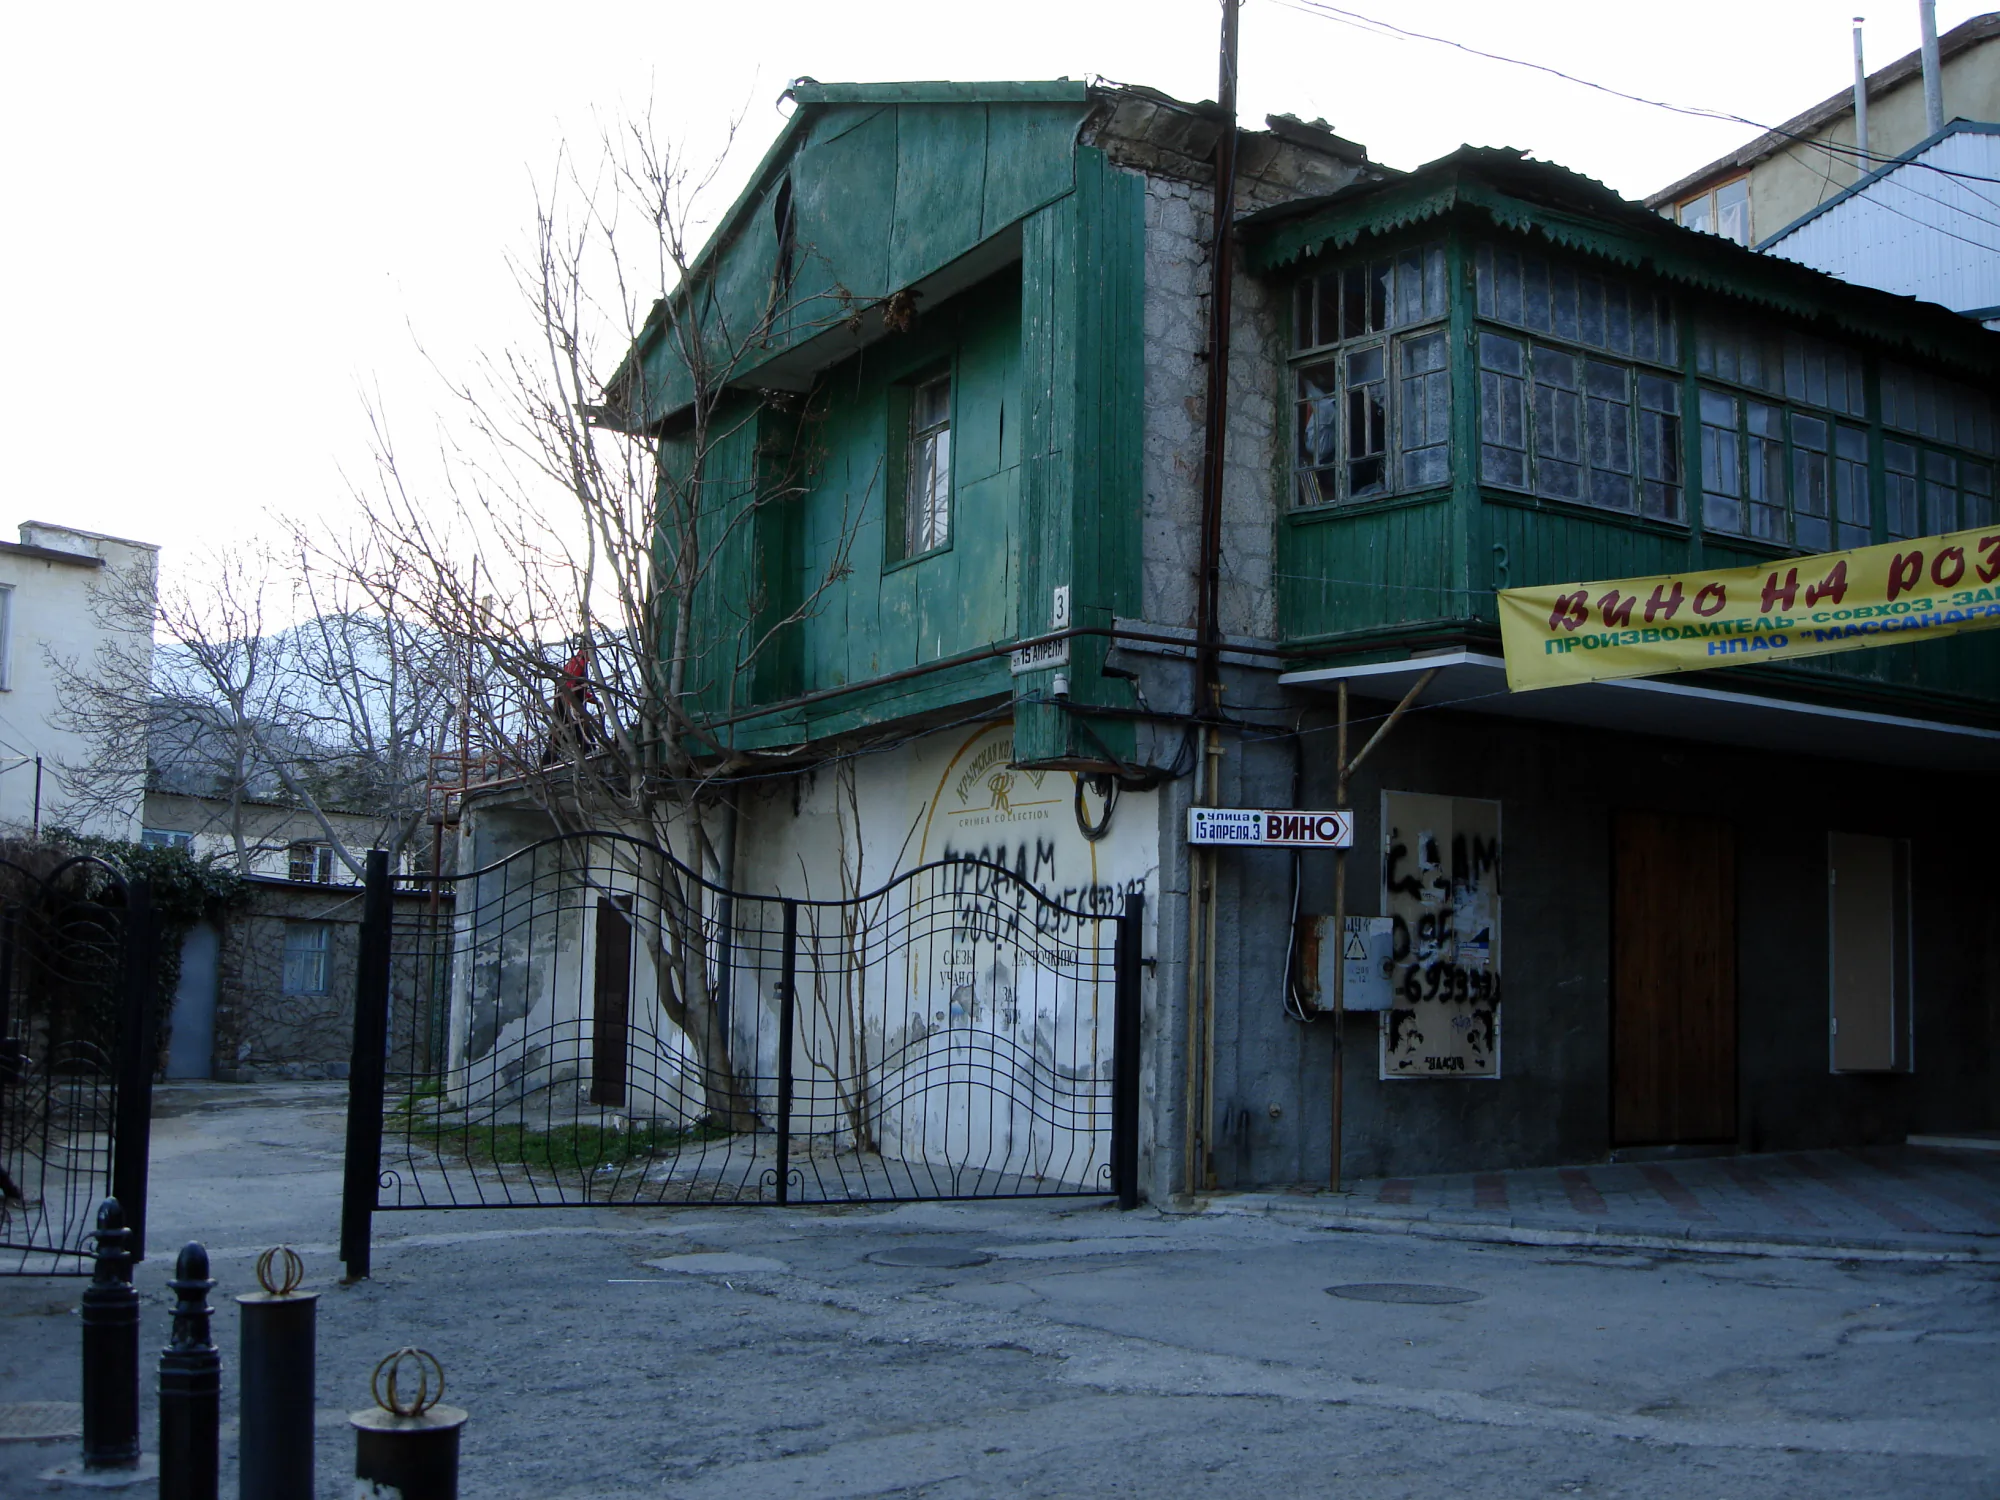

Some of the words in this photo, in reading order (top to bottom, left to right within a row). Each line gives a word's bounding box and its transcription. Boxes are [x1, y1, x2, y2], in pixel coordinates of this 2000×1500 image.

[1056, 594, 1064, 620] 3
[1548, 581, 1727, 632] ВИНО
[1760, 559, 1849, 614] НА
[1021, 646, 1031, 664] 15
[1033, 638, 1063, 662] АПРЕЛЯ
[1707, 631, 1789, 656] НПАО
[956, 742, 998, 806] КРЫМСКАЯ
[959, 816, 990, 828] CRIMEA
[995, 809, 1049, 823] COLLECTION
[1196, 821, 1207, 839] 15
[1266, 815, 1340, 841] ВИНО
[943, 838, 1055, 906] ПРОДАМ
